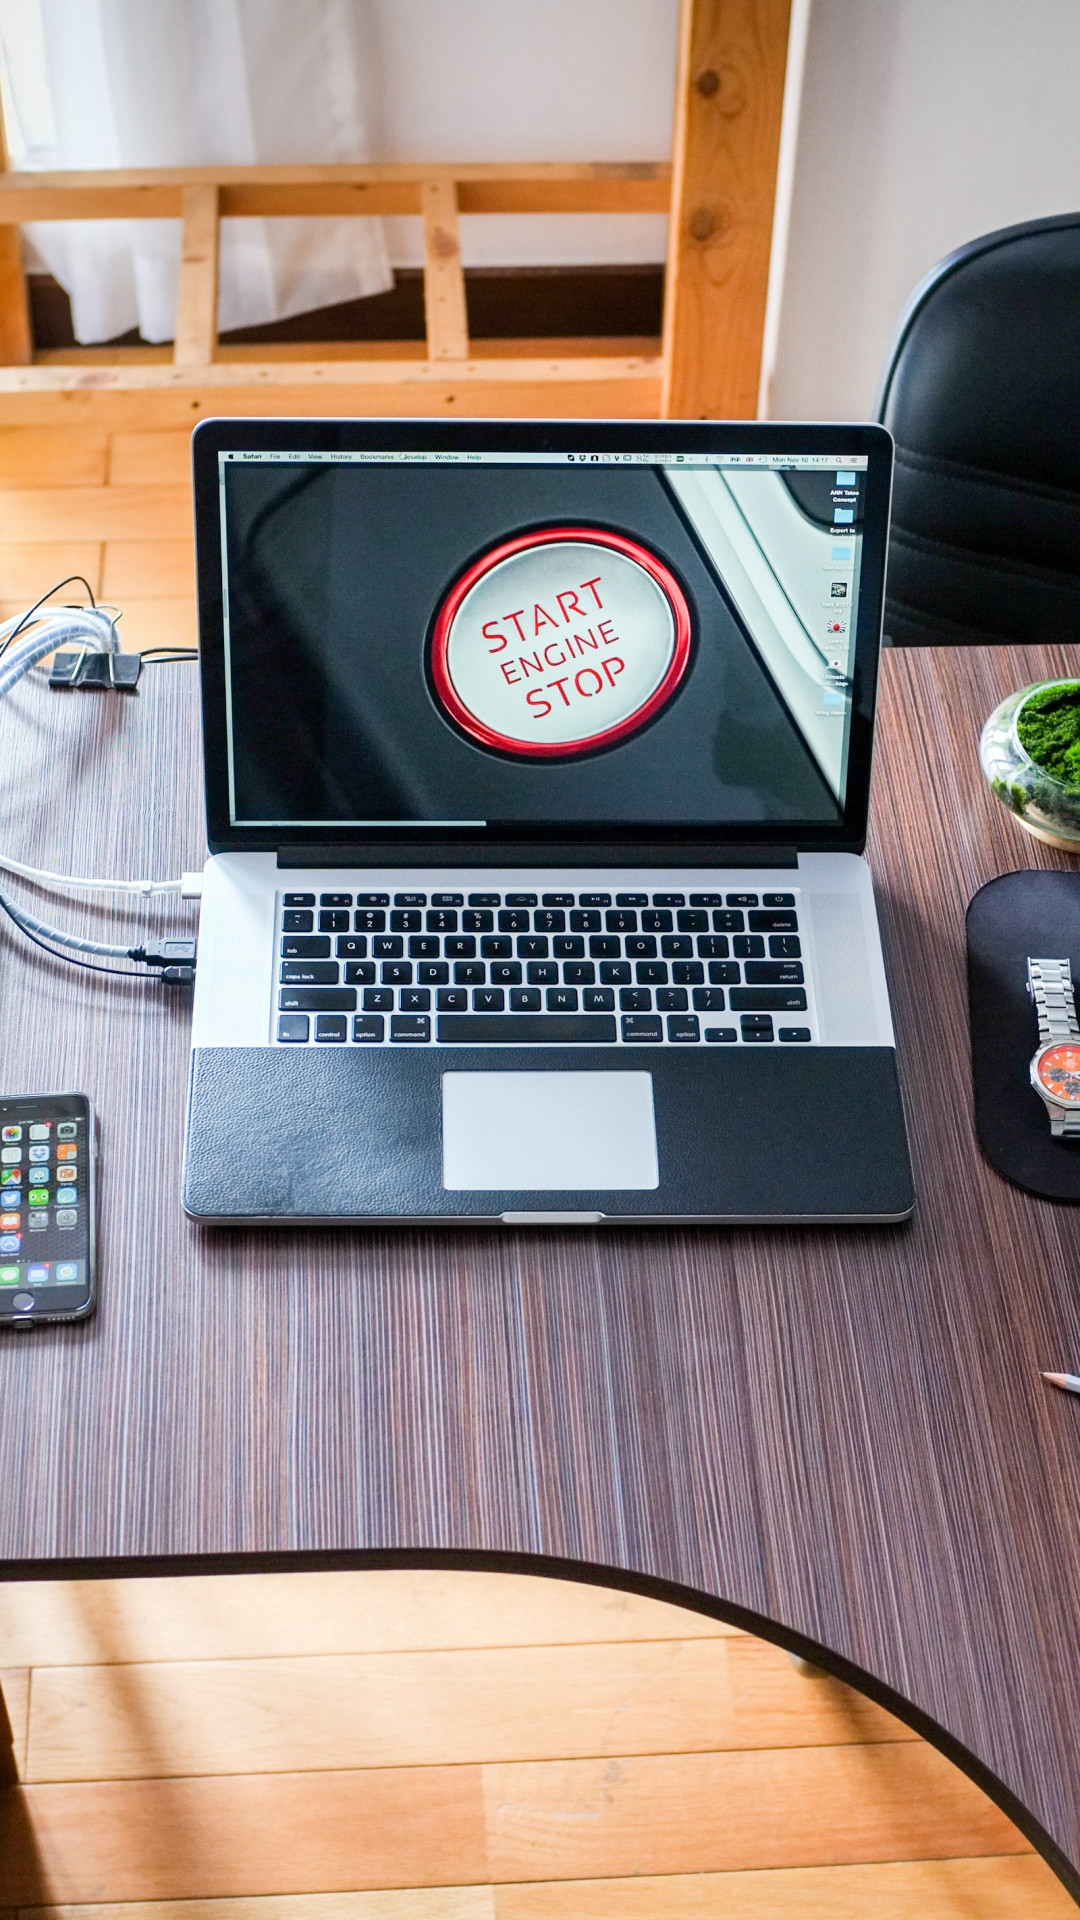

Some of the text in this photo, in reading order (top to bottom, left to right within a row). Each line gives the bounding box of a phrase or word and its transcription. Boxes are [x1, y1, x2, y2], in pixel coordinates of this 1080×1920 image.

[330, 453, 353, 461] History
[481, 576, 605, 654] START
[500, 619, 620, 685] ENGINE
[526, 656, 626, 719] STOP
